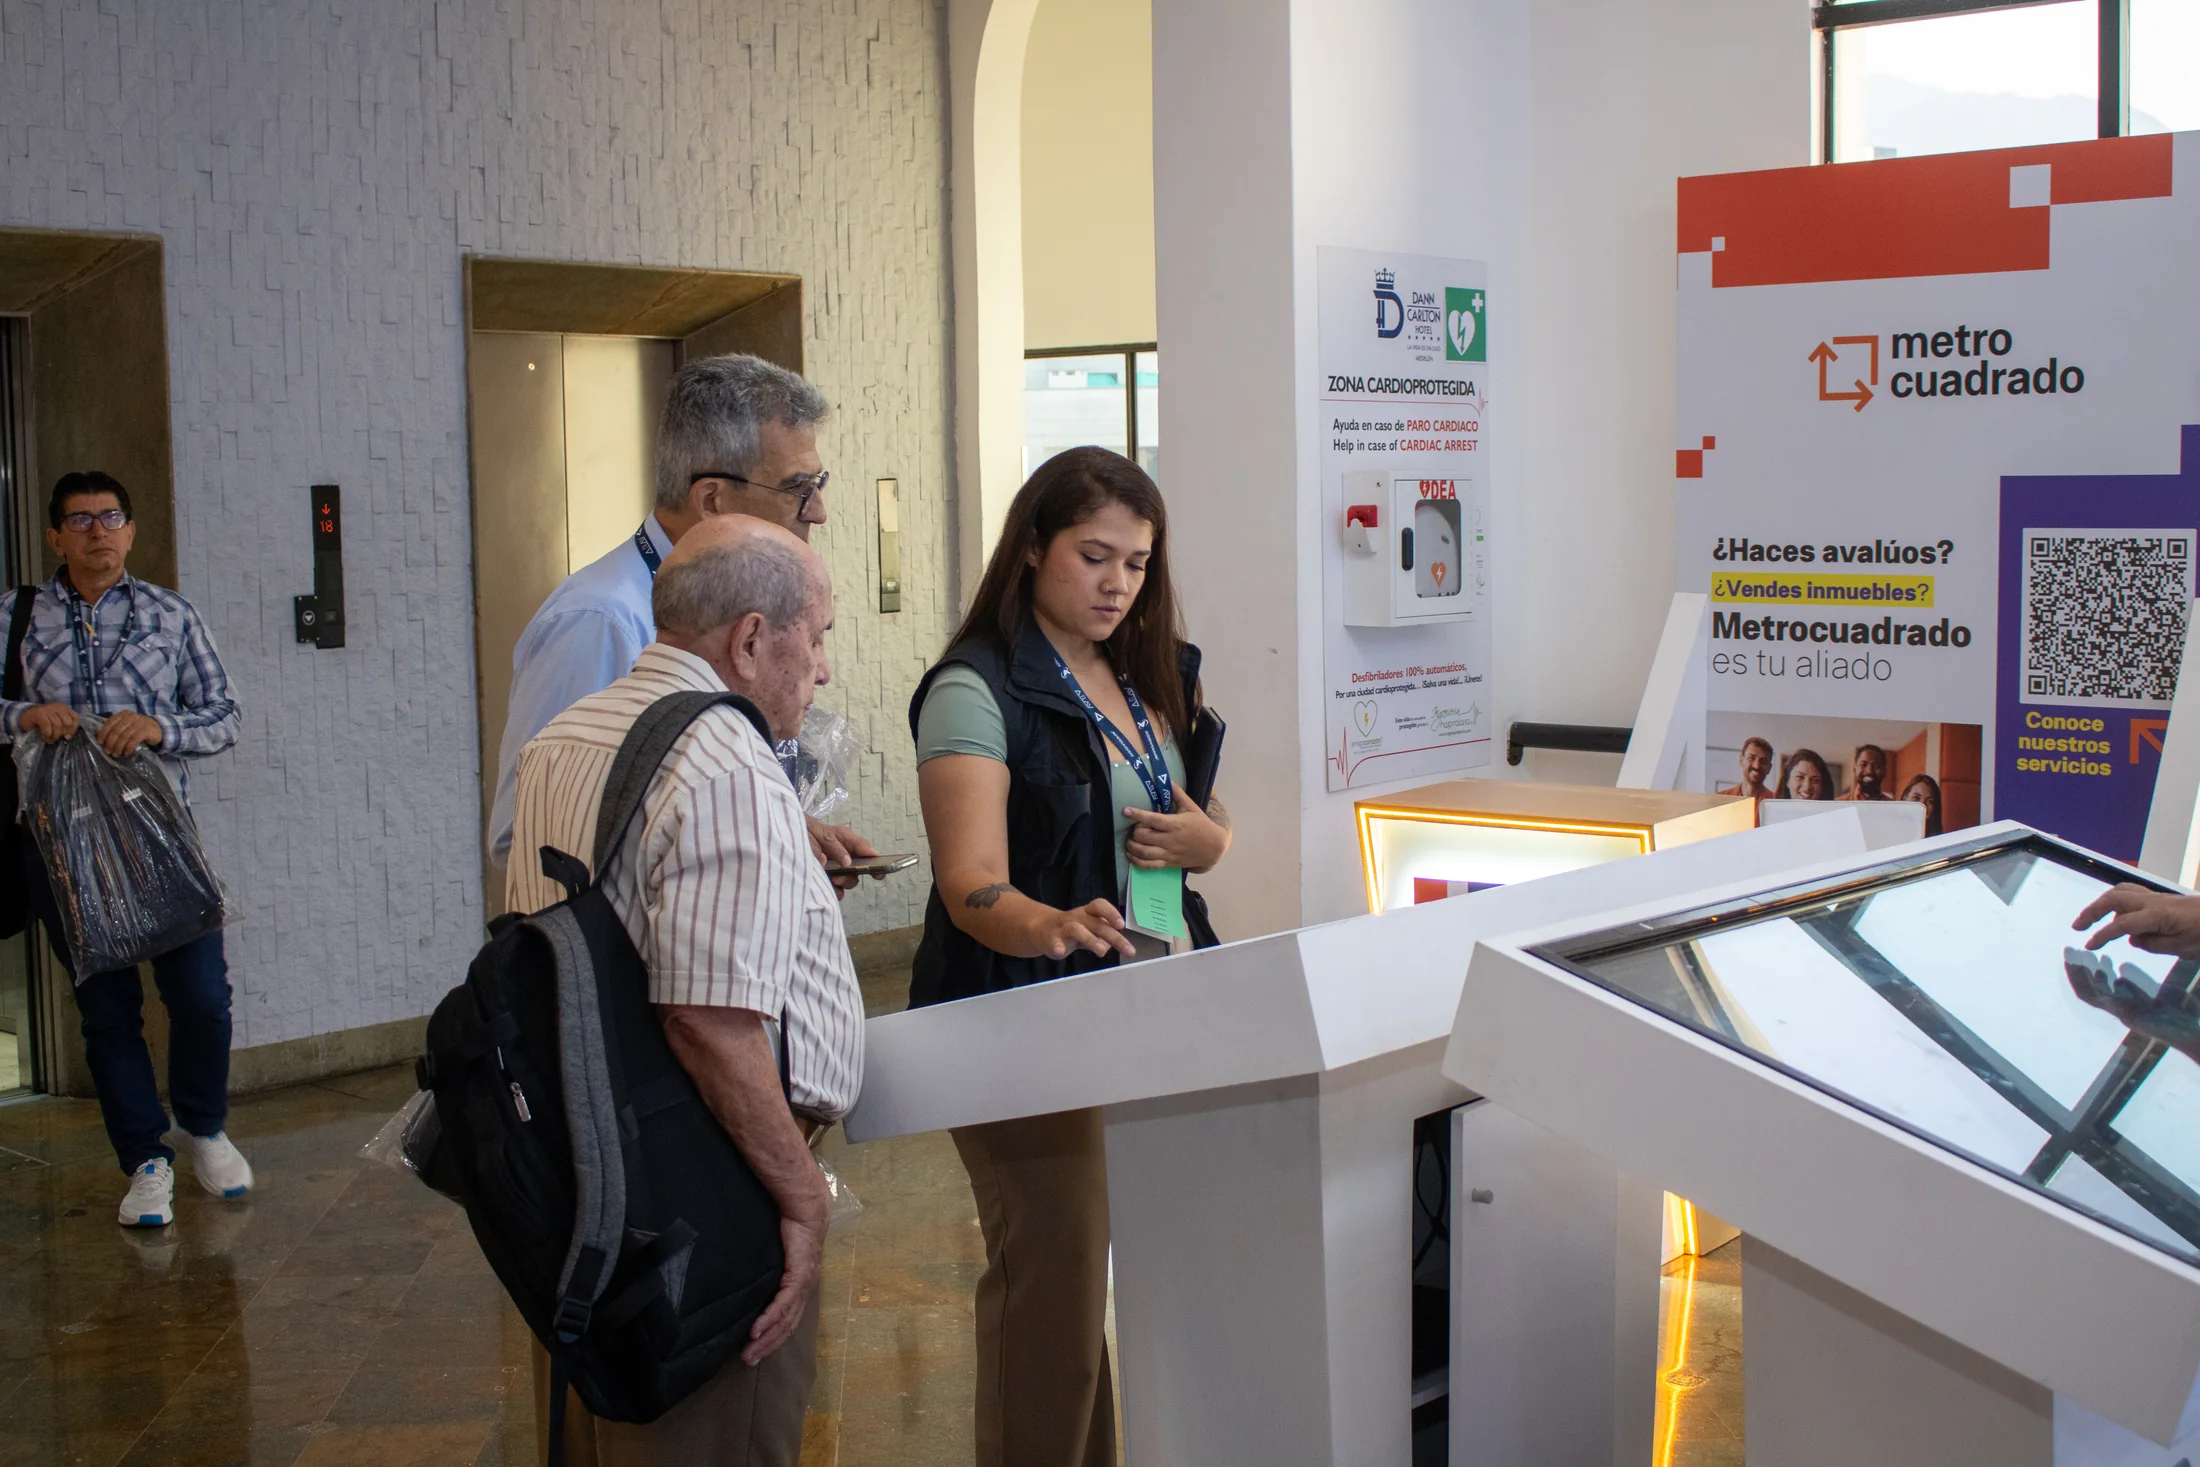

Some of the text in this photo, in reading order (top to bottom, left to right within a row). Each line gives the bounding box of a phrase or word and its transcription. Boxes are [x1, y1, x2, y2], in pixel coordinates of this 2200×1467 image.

[1412, 292, 1434, 305] DANN
[1407, 309, 1440, 323] CARLTON
[1415, 326, 1432, 334] HOTEL
[1892, 325, 2013, 359] metro
[1328, 375, 1475, 396] ZONA CARDIOPROTEGIDA
[1891, 358, 2085, 398] cuadrado
[1332, 418, 1478, 434] Ayuda en caso de PARO CARDIACO
[1333, 439, 1478, 454] Help in case of CARDIAC ARREST
[1431, 480, 1456, 500] DEA
[320, 520, 334, 533] 18
[1713, 538, 1954, 564] ¿Haces avalúos?
[1715, 580, 1930, 602] ¿Vendes inmuebles?
[1713, 612, 1972, 648] Metrocuadrado
[1352, 669, 1403, 683] Desfibriladores
[1406, 666, 1424, 677] 100%
[1712, 650, 1892, 681] es tu aliado
[1336, 690, 1345, 699] Por
[1357, 687, 1374, 697] ciudad
[1438, 679, 1447, 687] una
[2026, 712, 2104, 732] Conoce
[2018, 734, 2110, 754] nuestros
[2017, 756, 2112, 776] servicios
